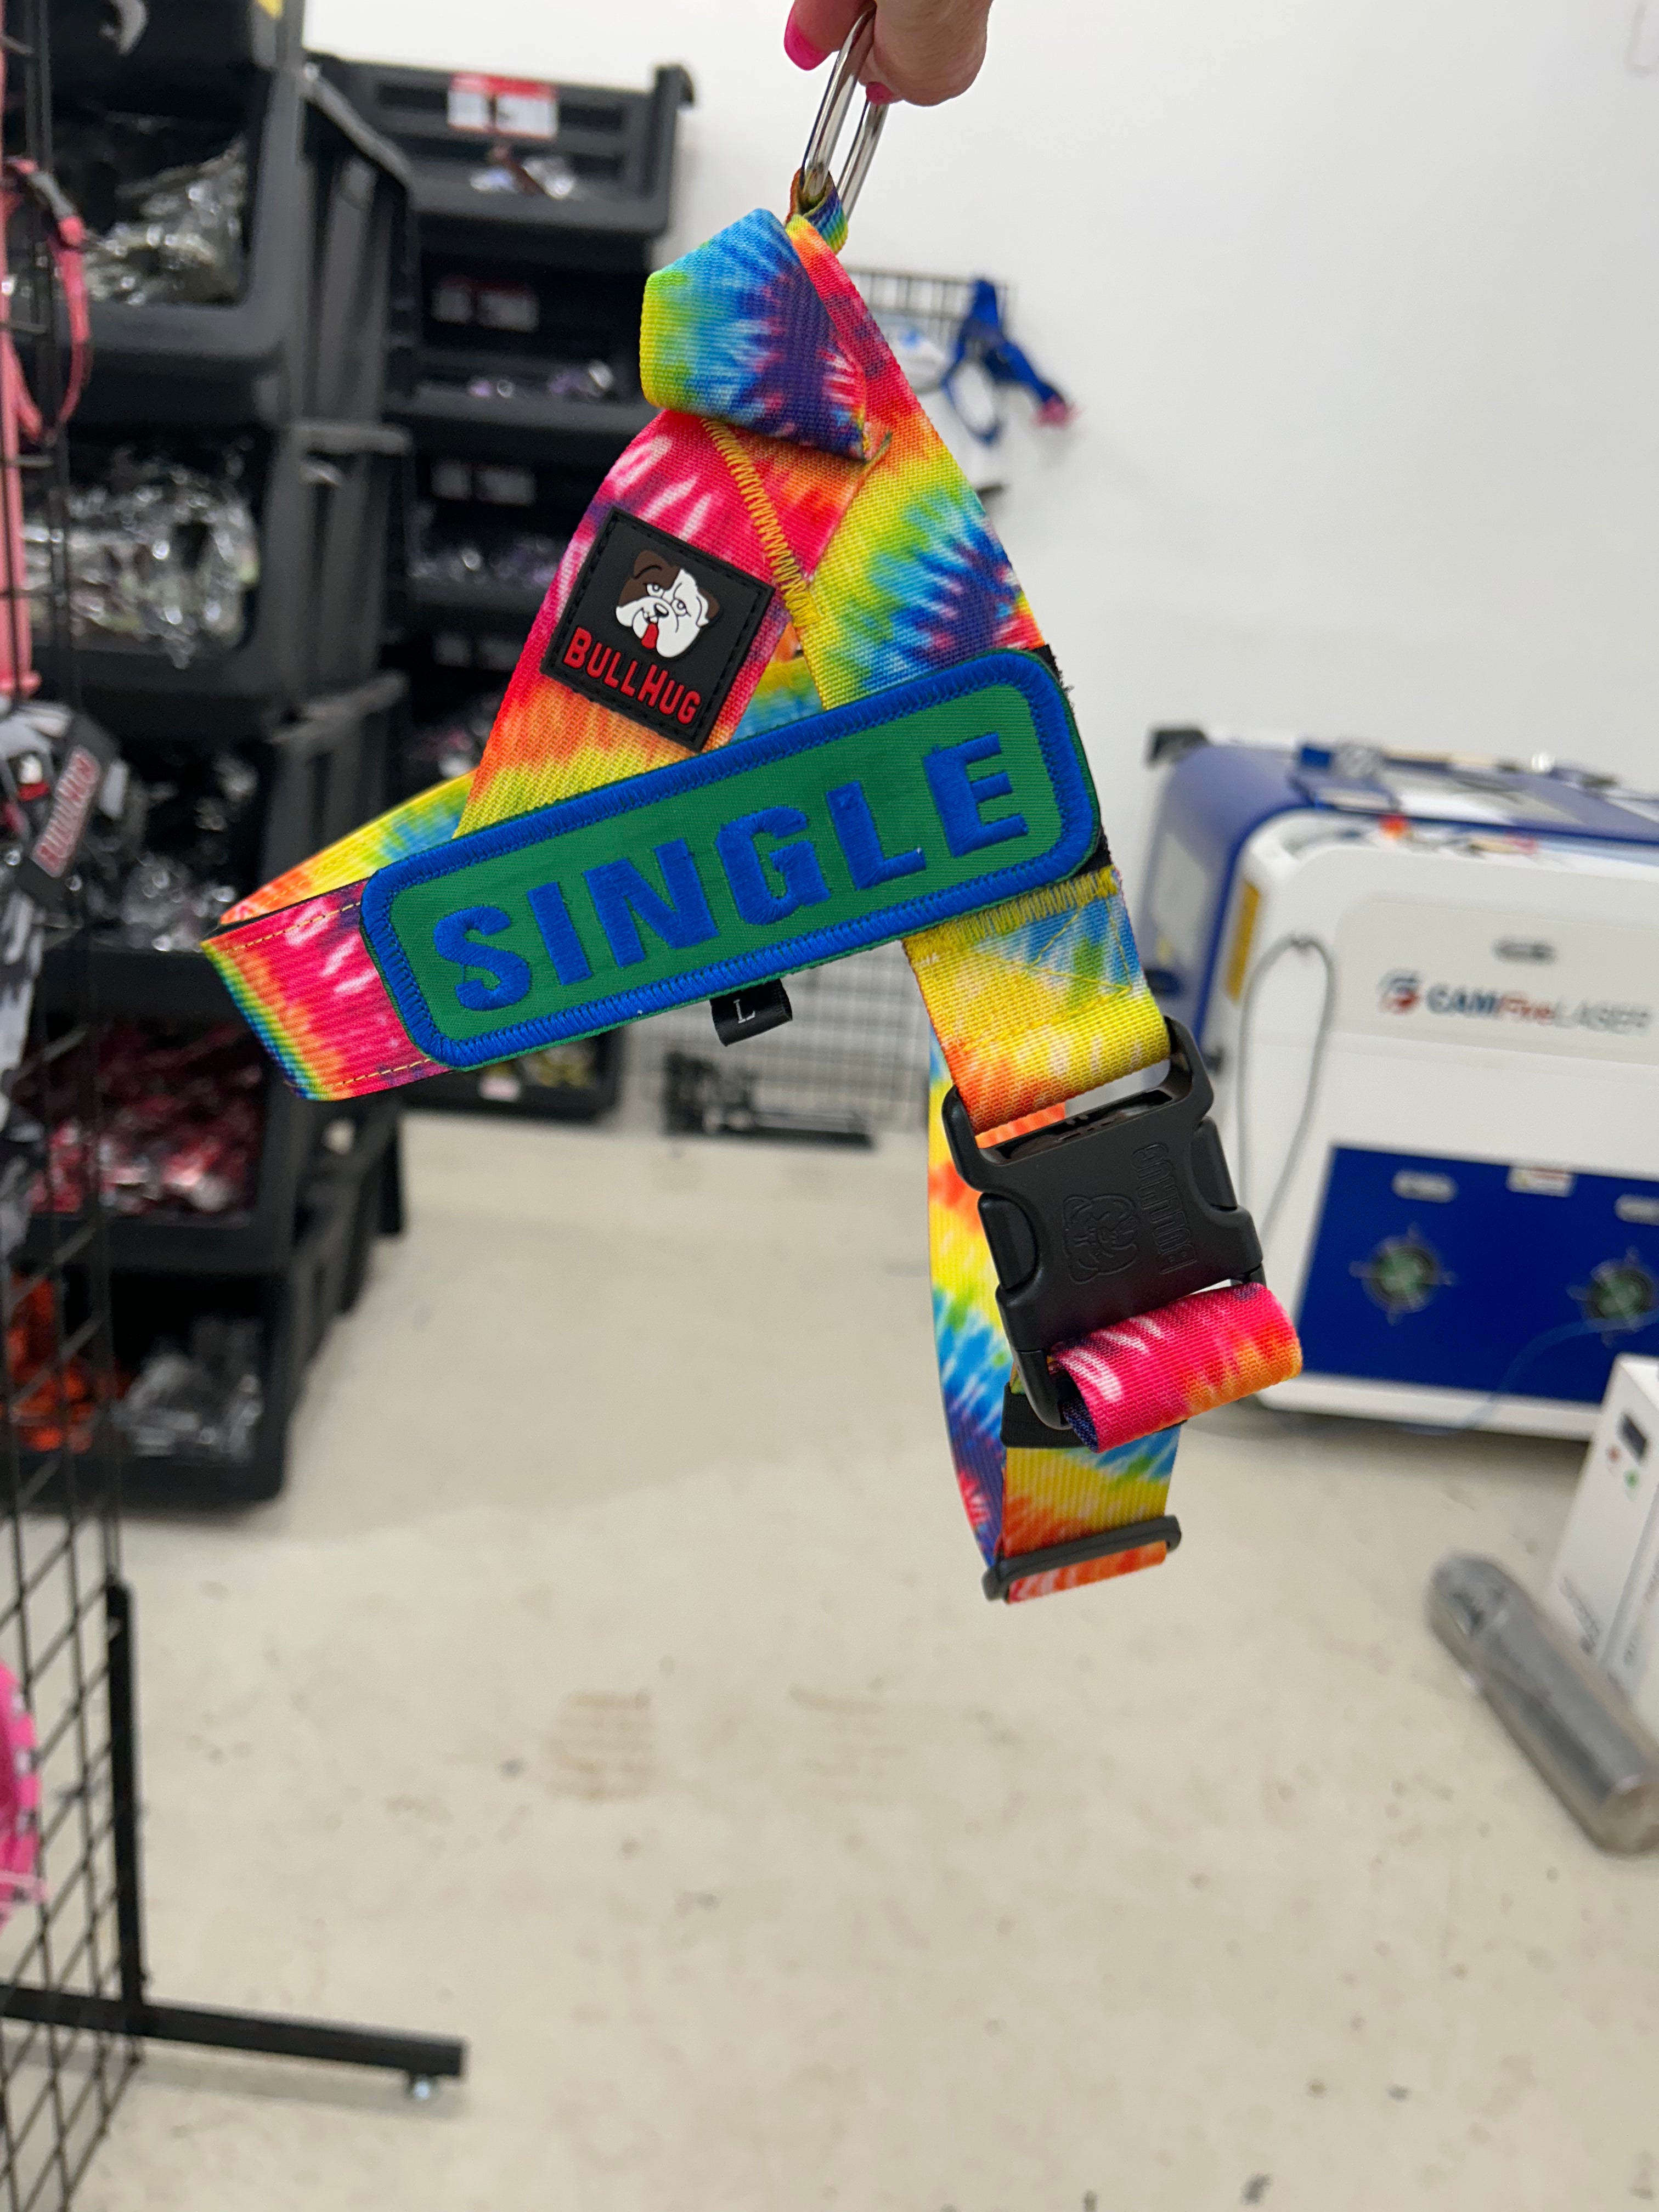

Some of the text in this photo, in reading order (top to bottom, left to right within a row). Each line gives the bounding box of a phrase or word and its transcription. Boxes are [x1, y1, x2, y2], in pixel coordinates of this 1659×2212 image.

[563, 627, 702, 724] BULLHUG
[433, 732, 1029, 1011] SINGLE
[733, 998, 755, 1024] L
[1132, 1142, 1198, 1274] BULLHUG
